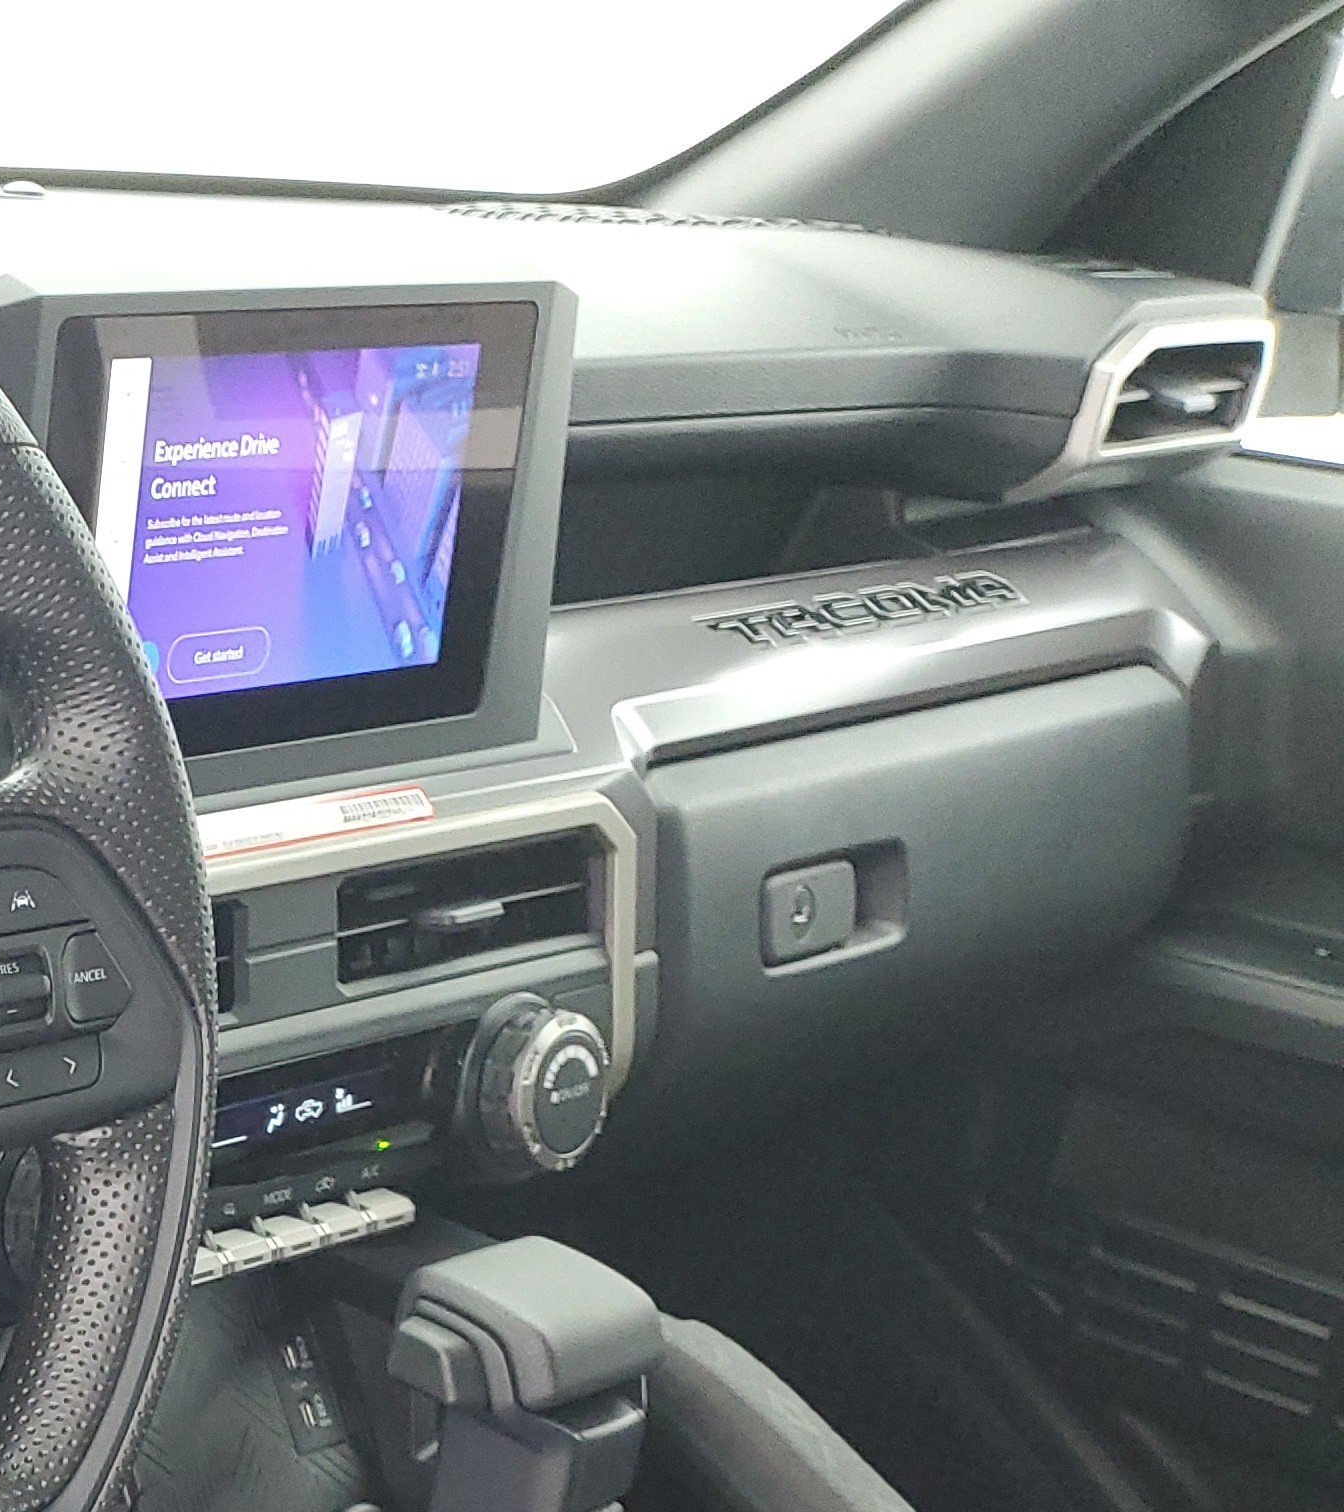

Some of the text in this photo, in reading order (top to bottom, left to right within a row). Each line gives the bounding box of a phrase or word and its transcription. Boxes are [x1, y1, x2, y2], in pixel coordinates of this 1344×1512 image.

[154, 432, 281, 466] Experience Drive
[150, 474, 217, 500] Connect
[700, 568, 1026, 648] TACOMA
